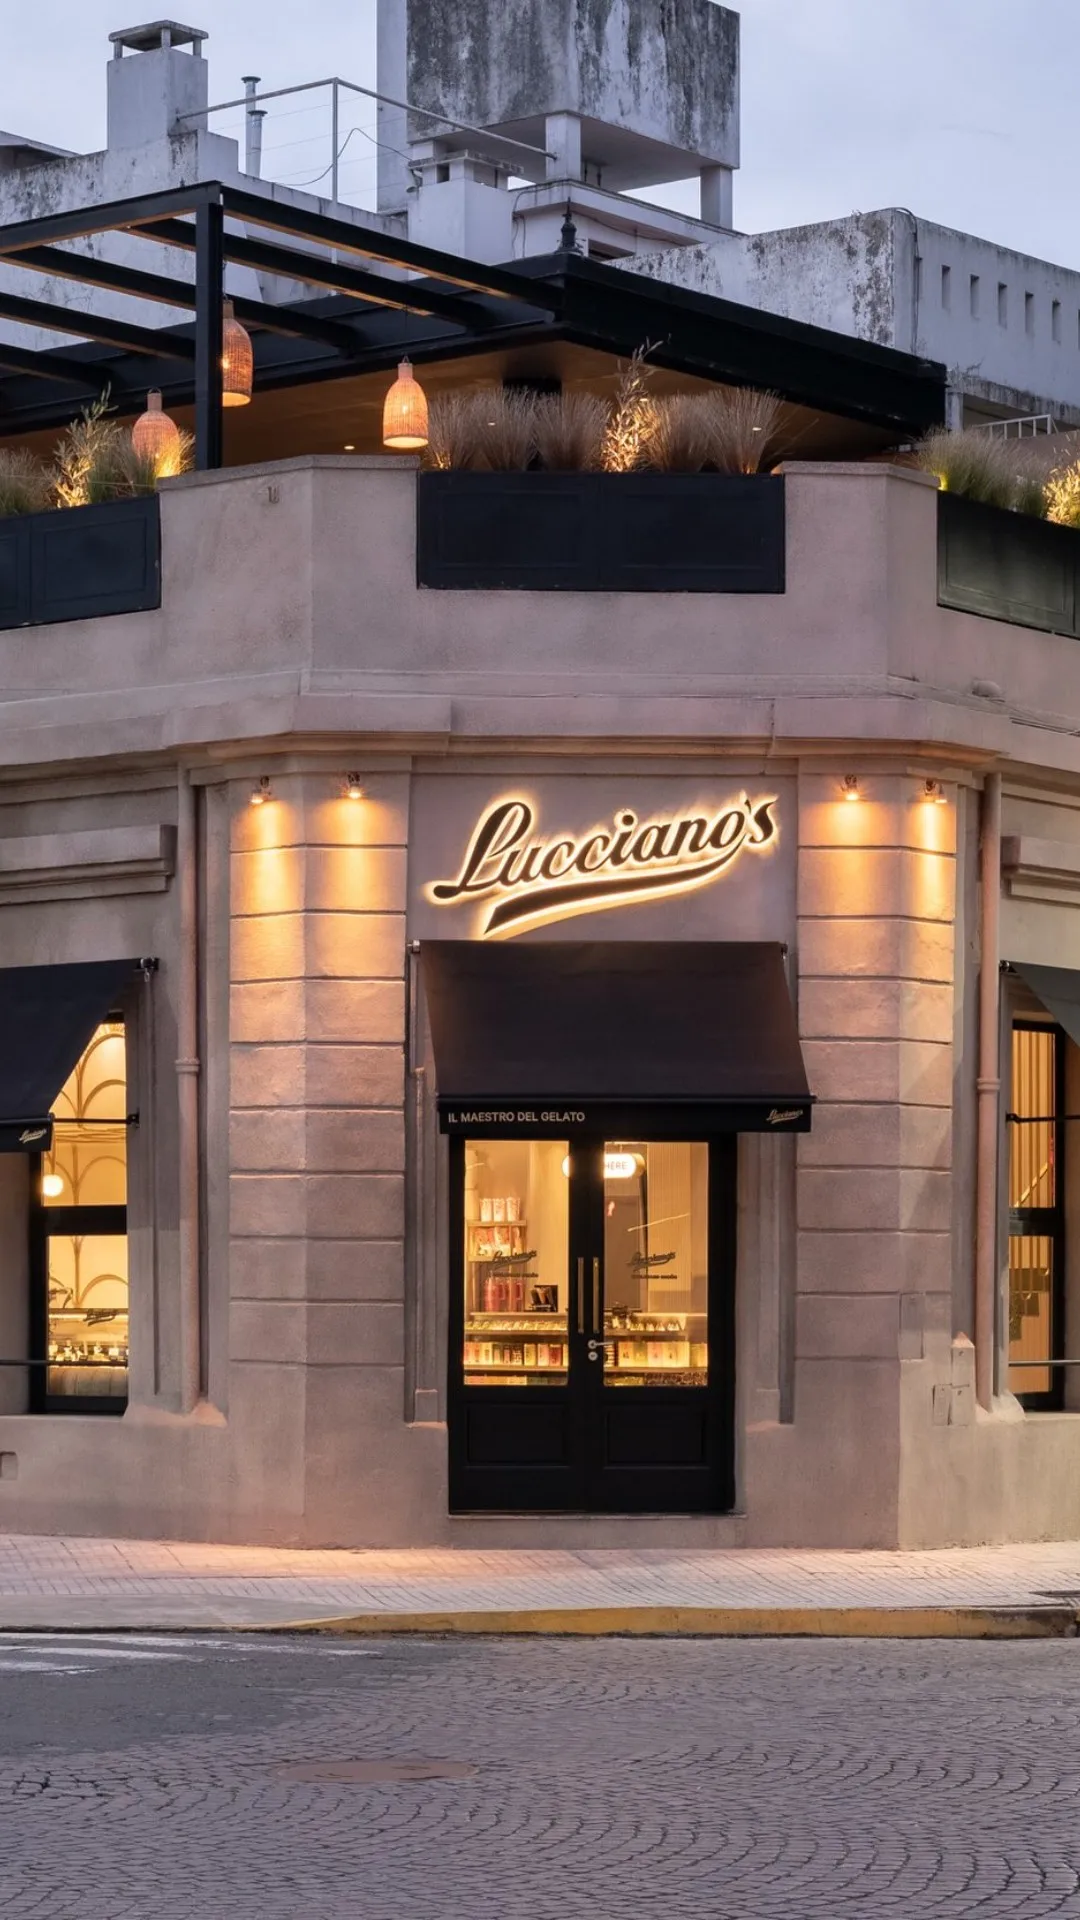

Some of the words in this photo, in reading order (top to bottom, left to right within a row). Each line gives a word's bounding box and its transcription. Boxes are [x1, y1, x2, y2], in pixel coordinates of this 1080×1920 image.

[431, 796, 777, 901] Lucciano's
[448, 1112, 458, 1123] IL
[460, 1112, 515, 1122] MAESTRO
[517, 1111, 538, 1122] DEL
[540, 1111, 586, 1122] GELATO
